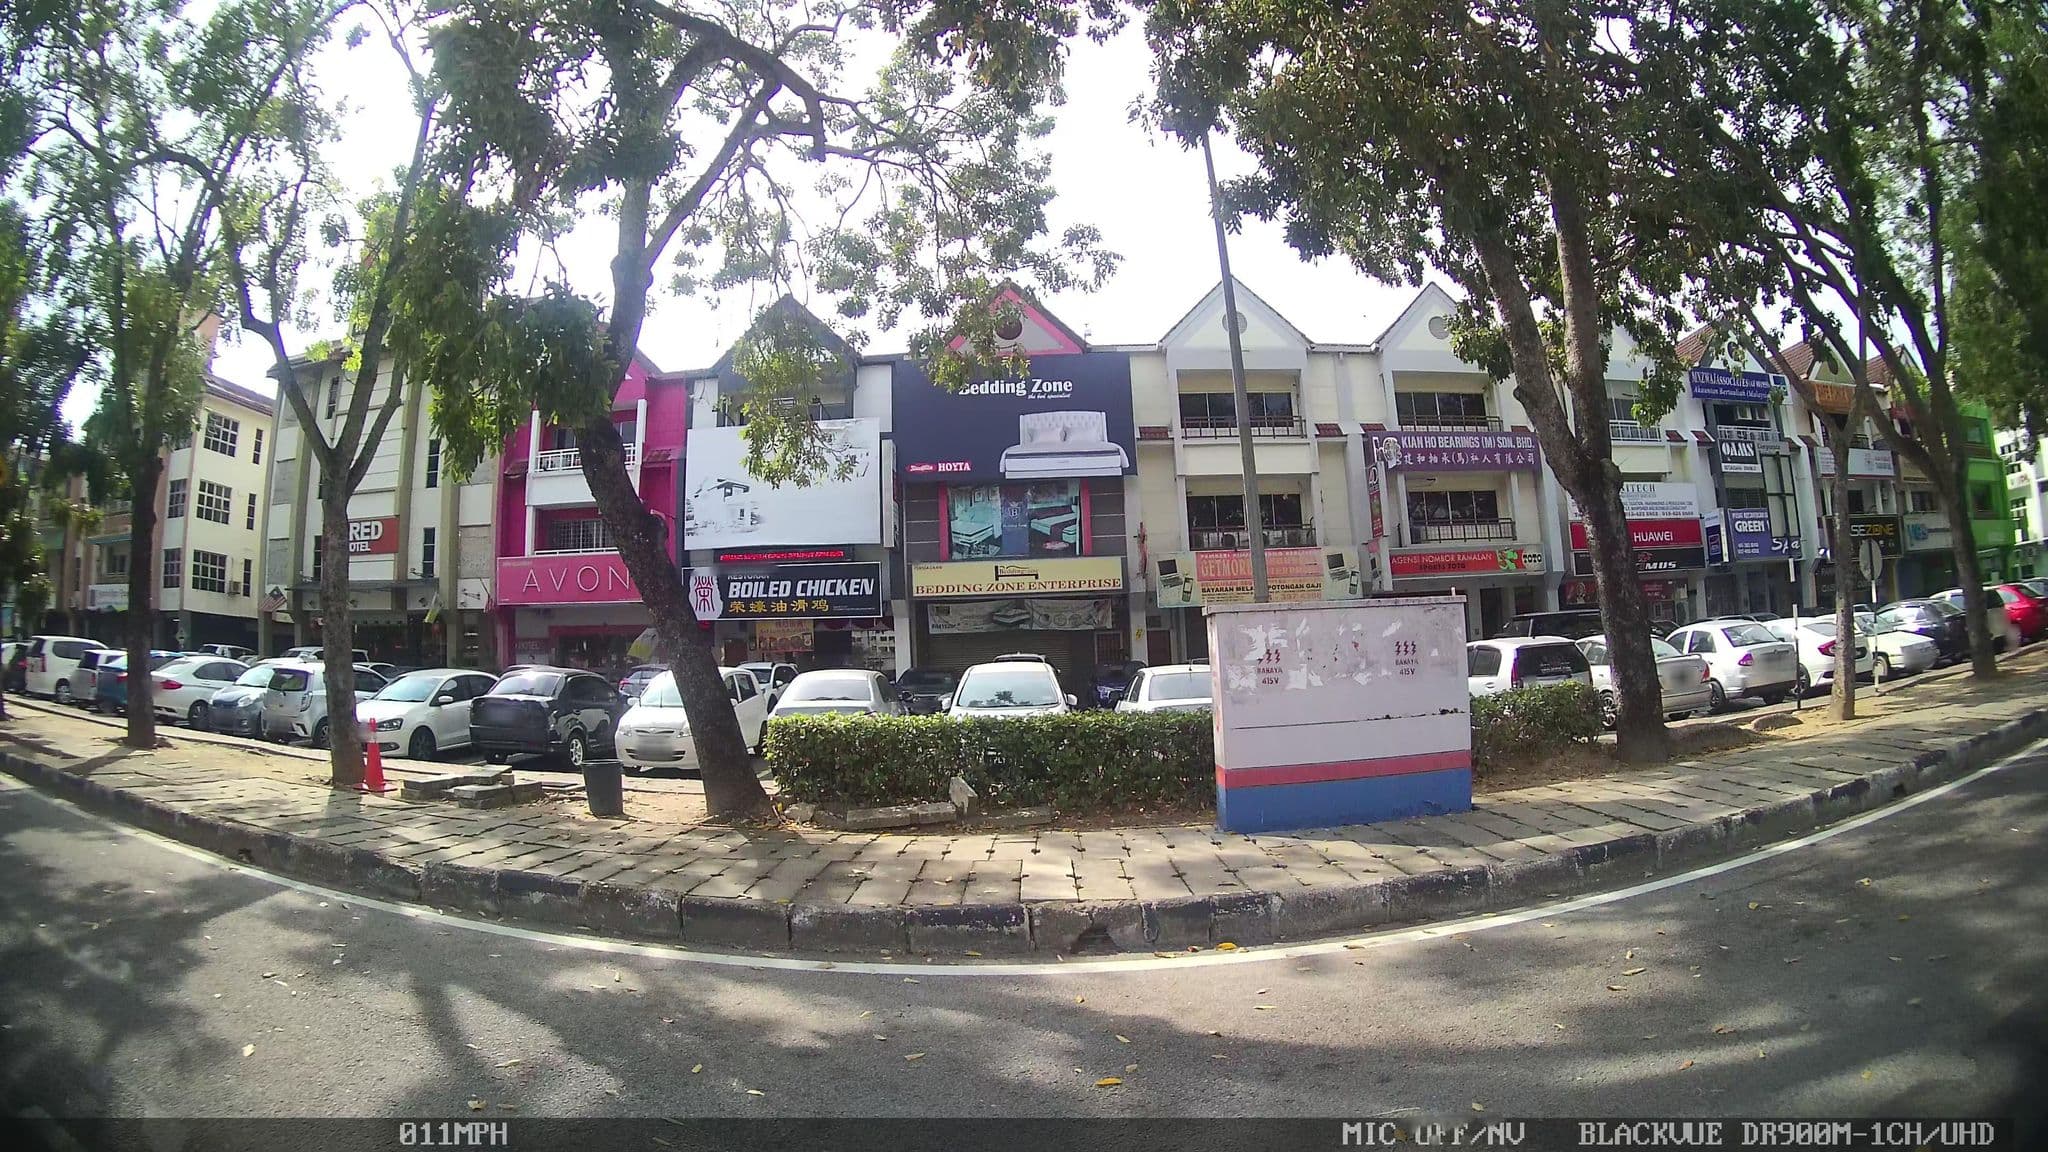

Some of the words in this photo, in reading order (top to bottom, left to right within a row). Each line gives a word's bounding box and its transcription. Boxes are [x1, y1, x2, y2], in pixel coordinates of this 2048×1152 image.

[1031, 378, 1073, 393] Zone
[1401, 436, 1424, 448] KIAN
[1425, 436, 1437, 448] HO
[1440, 436, 1480, 448] BEARINGS
[1481, 436, 1496, 448] (M)
[1497, 436, 1516, 448] SDN.
[1516, 437, 1535, 448] BHD.
[938, 462, 971, 471] HOYTA
[349, 521, 383, 541] RED
[1735, 520, 1765, 532] GREEN
[1850, 524, 1894, 536] SEZONE
[1633, 532, 1674, 542] HUAWEI
[349, 542, 371, 552] OTEL
[1522, 553, 1543, 563] TOTO
[522, 565, 630, 593] AVON
[727, 580, 792, 598] BOILED
[796, 578, 874, 597] CHICKEN
[915, 584, 983, 595] BEDDING
[986, 582, 1025, 592] ZONE
[1028, 578, 1121, 590] ENTERPRISE
